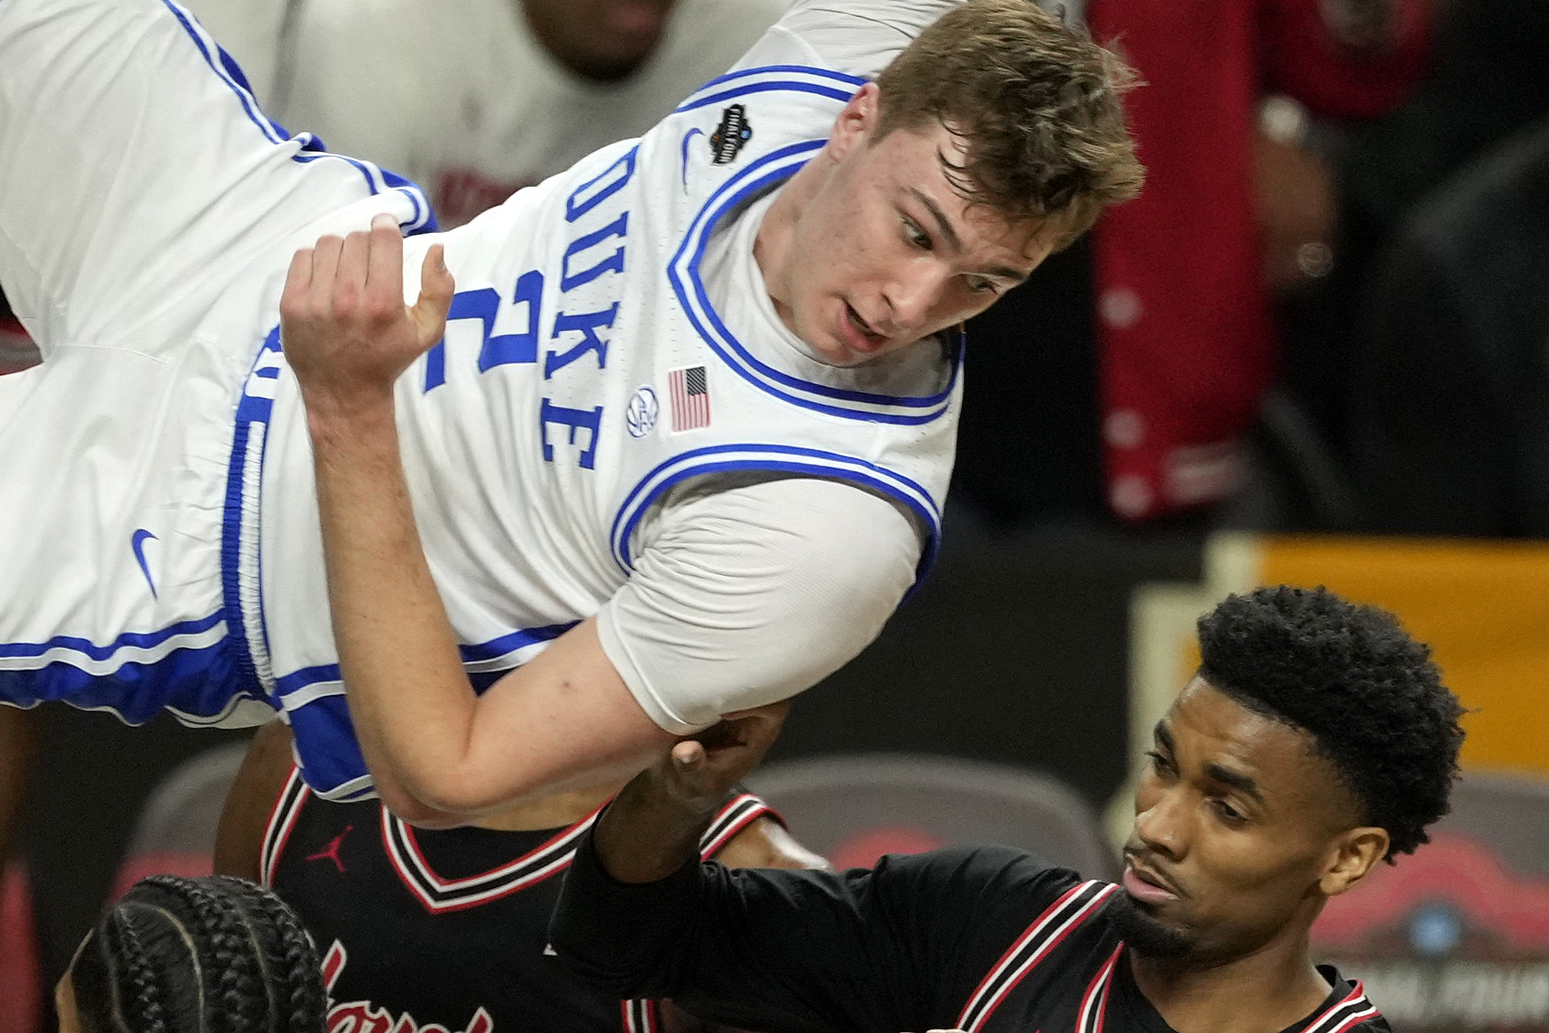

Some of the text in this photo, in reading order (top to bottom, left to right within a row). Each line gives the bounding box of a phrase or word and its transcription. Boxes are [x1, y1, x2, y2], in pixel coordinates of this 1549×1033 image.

[725, 108, 740, 136] FINAL
[423, 270, 544, 395] 2
[540, 142, 643, 469] DUKE
